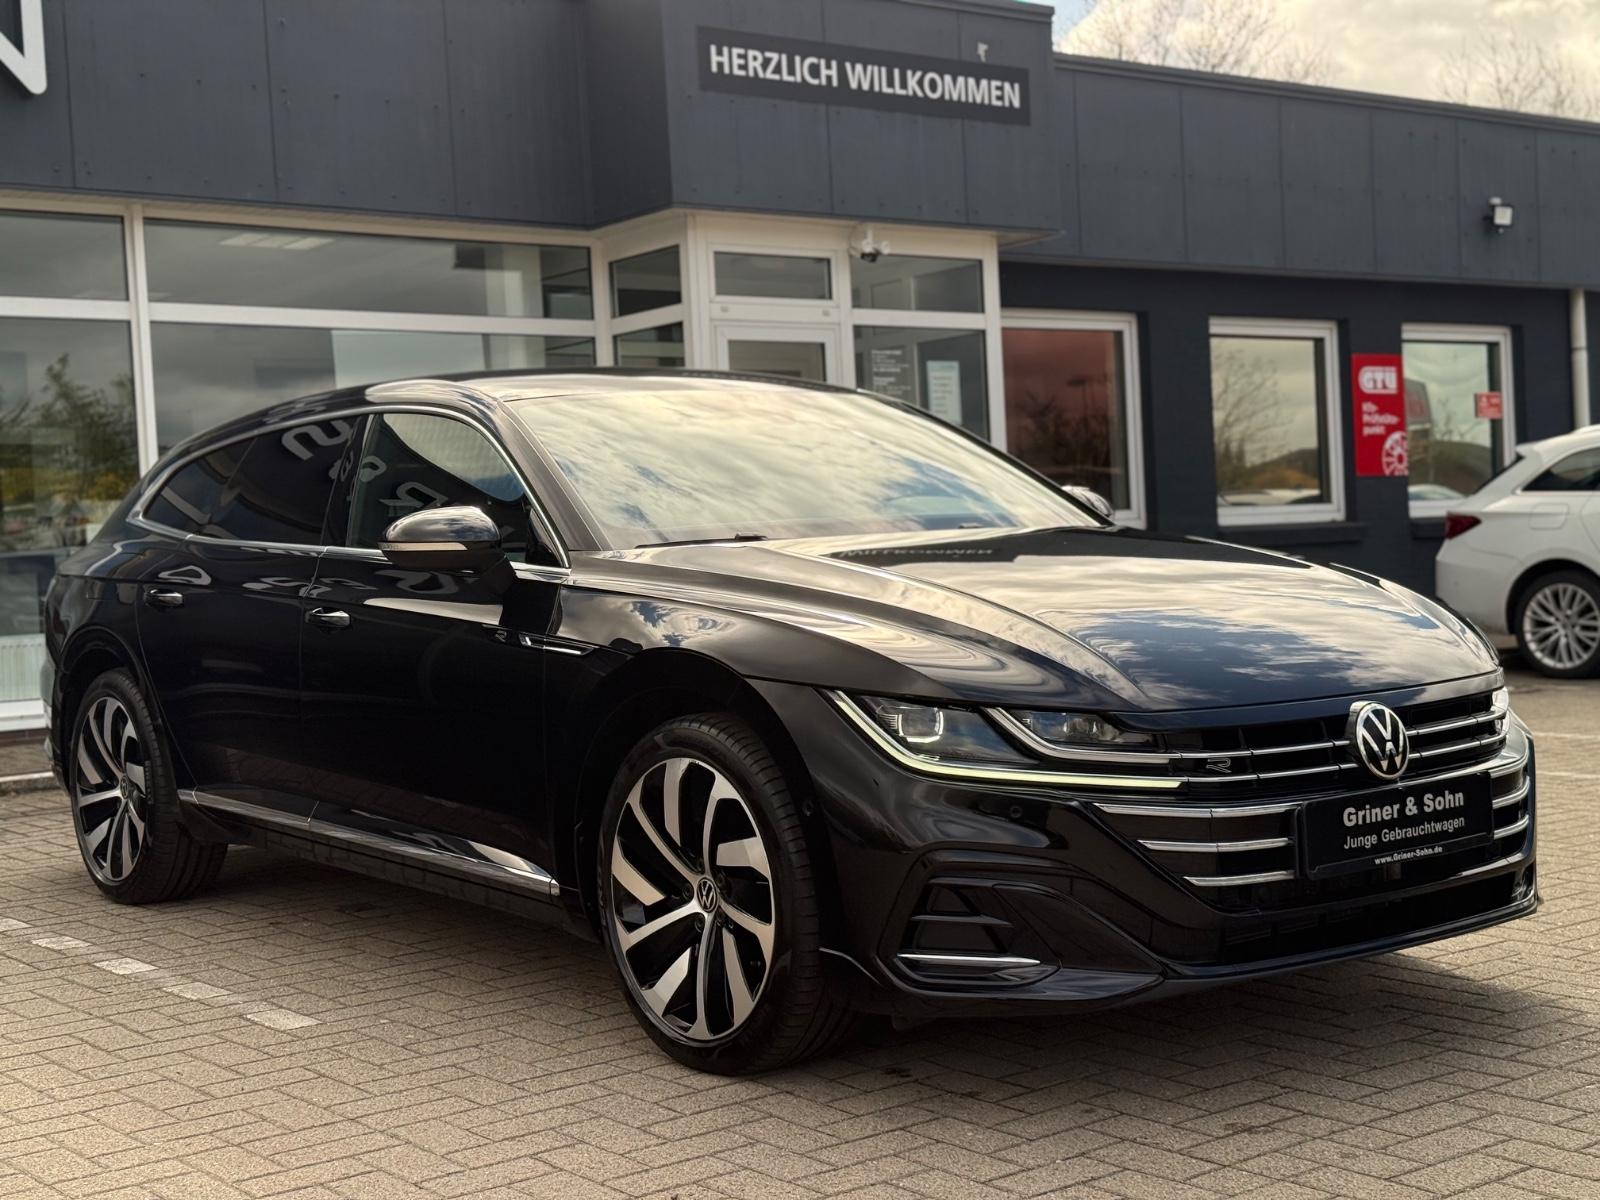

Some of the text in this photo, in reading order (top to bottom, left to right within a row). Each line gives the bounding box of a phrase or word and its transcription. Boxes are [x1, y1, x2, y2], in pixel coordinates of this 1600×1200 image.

[709, 44, 1020, 109] HERZLICH WILLKOMMEN
[1343, 790, 1464, 827] Griner & Sohn
[1343, 816, 1465, 849] Junge Gebrauchtwagen
[1374, 845, 1443, 865] www.Griner-Sohn.de
